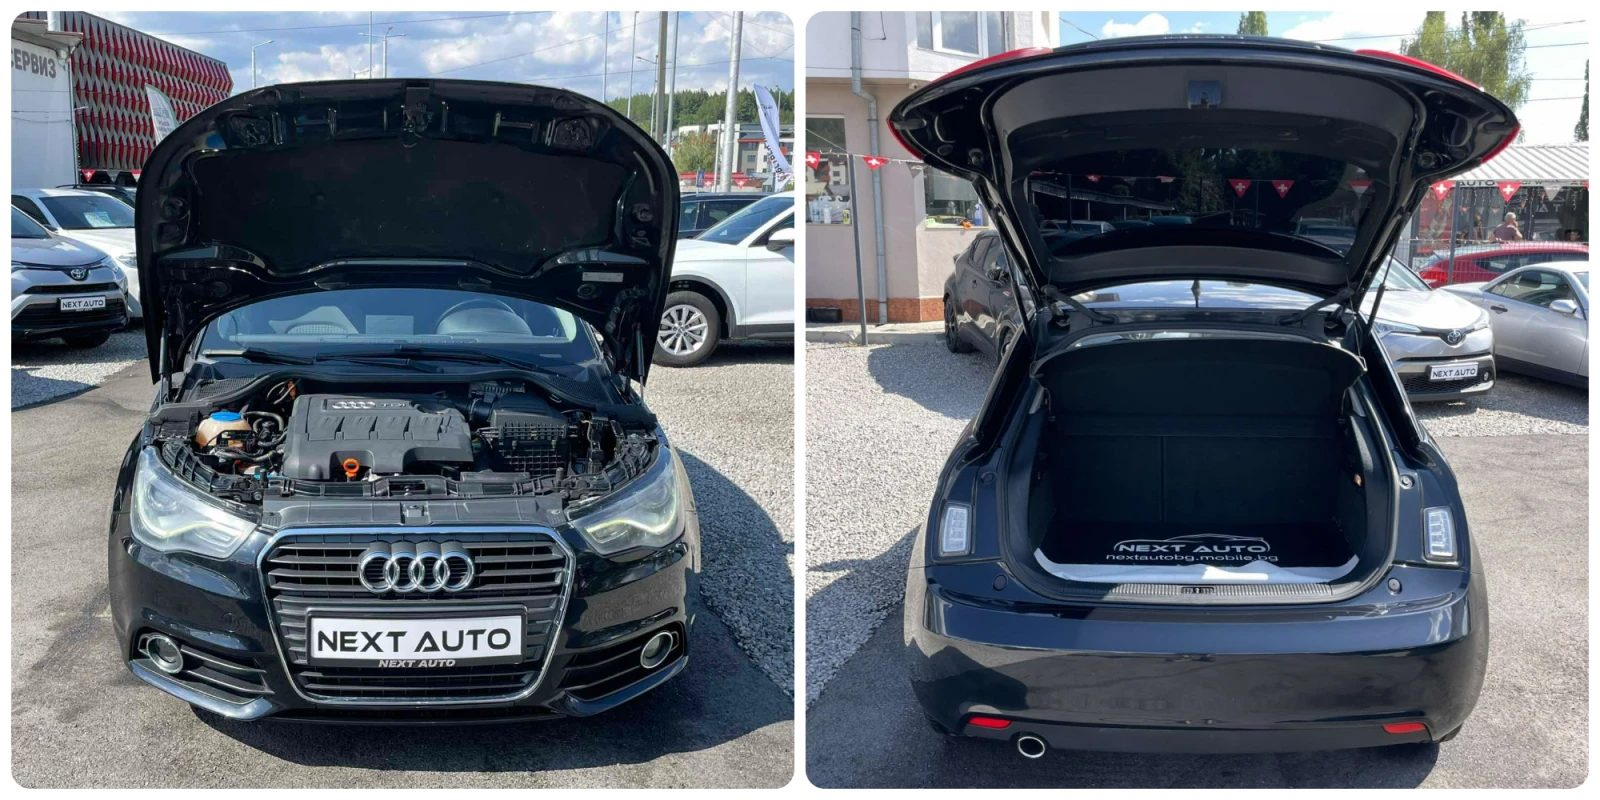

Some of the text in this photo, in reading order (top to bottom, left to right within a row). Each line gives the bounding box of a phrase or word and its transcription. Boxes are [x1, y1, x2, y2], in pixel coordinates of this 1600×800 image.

[1432, 368, 1476, 378] NEXT AUTO
[1118, 544, 1267, 553] NEXT AUTO
[1106, 554, 1278, 562] nextautobg.mobile.bg
[317, 628, 512, 653] NEXT AUTO
[379, 659, 456, 668] NEXT AUTO
